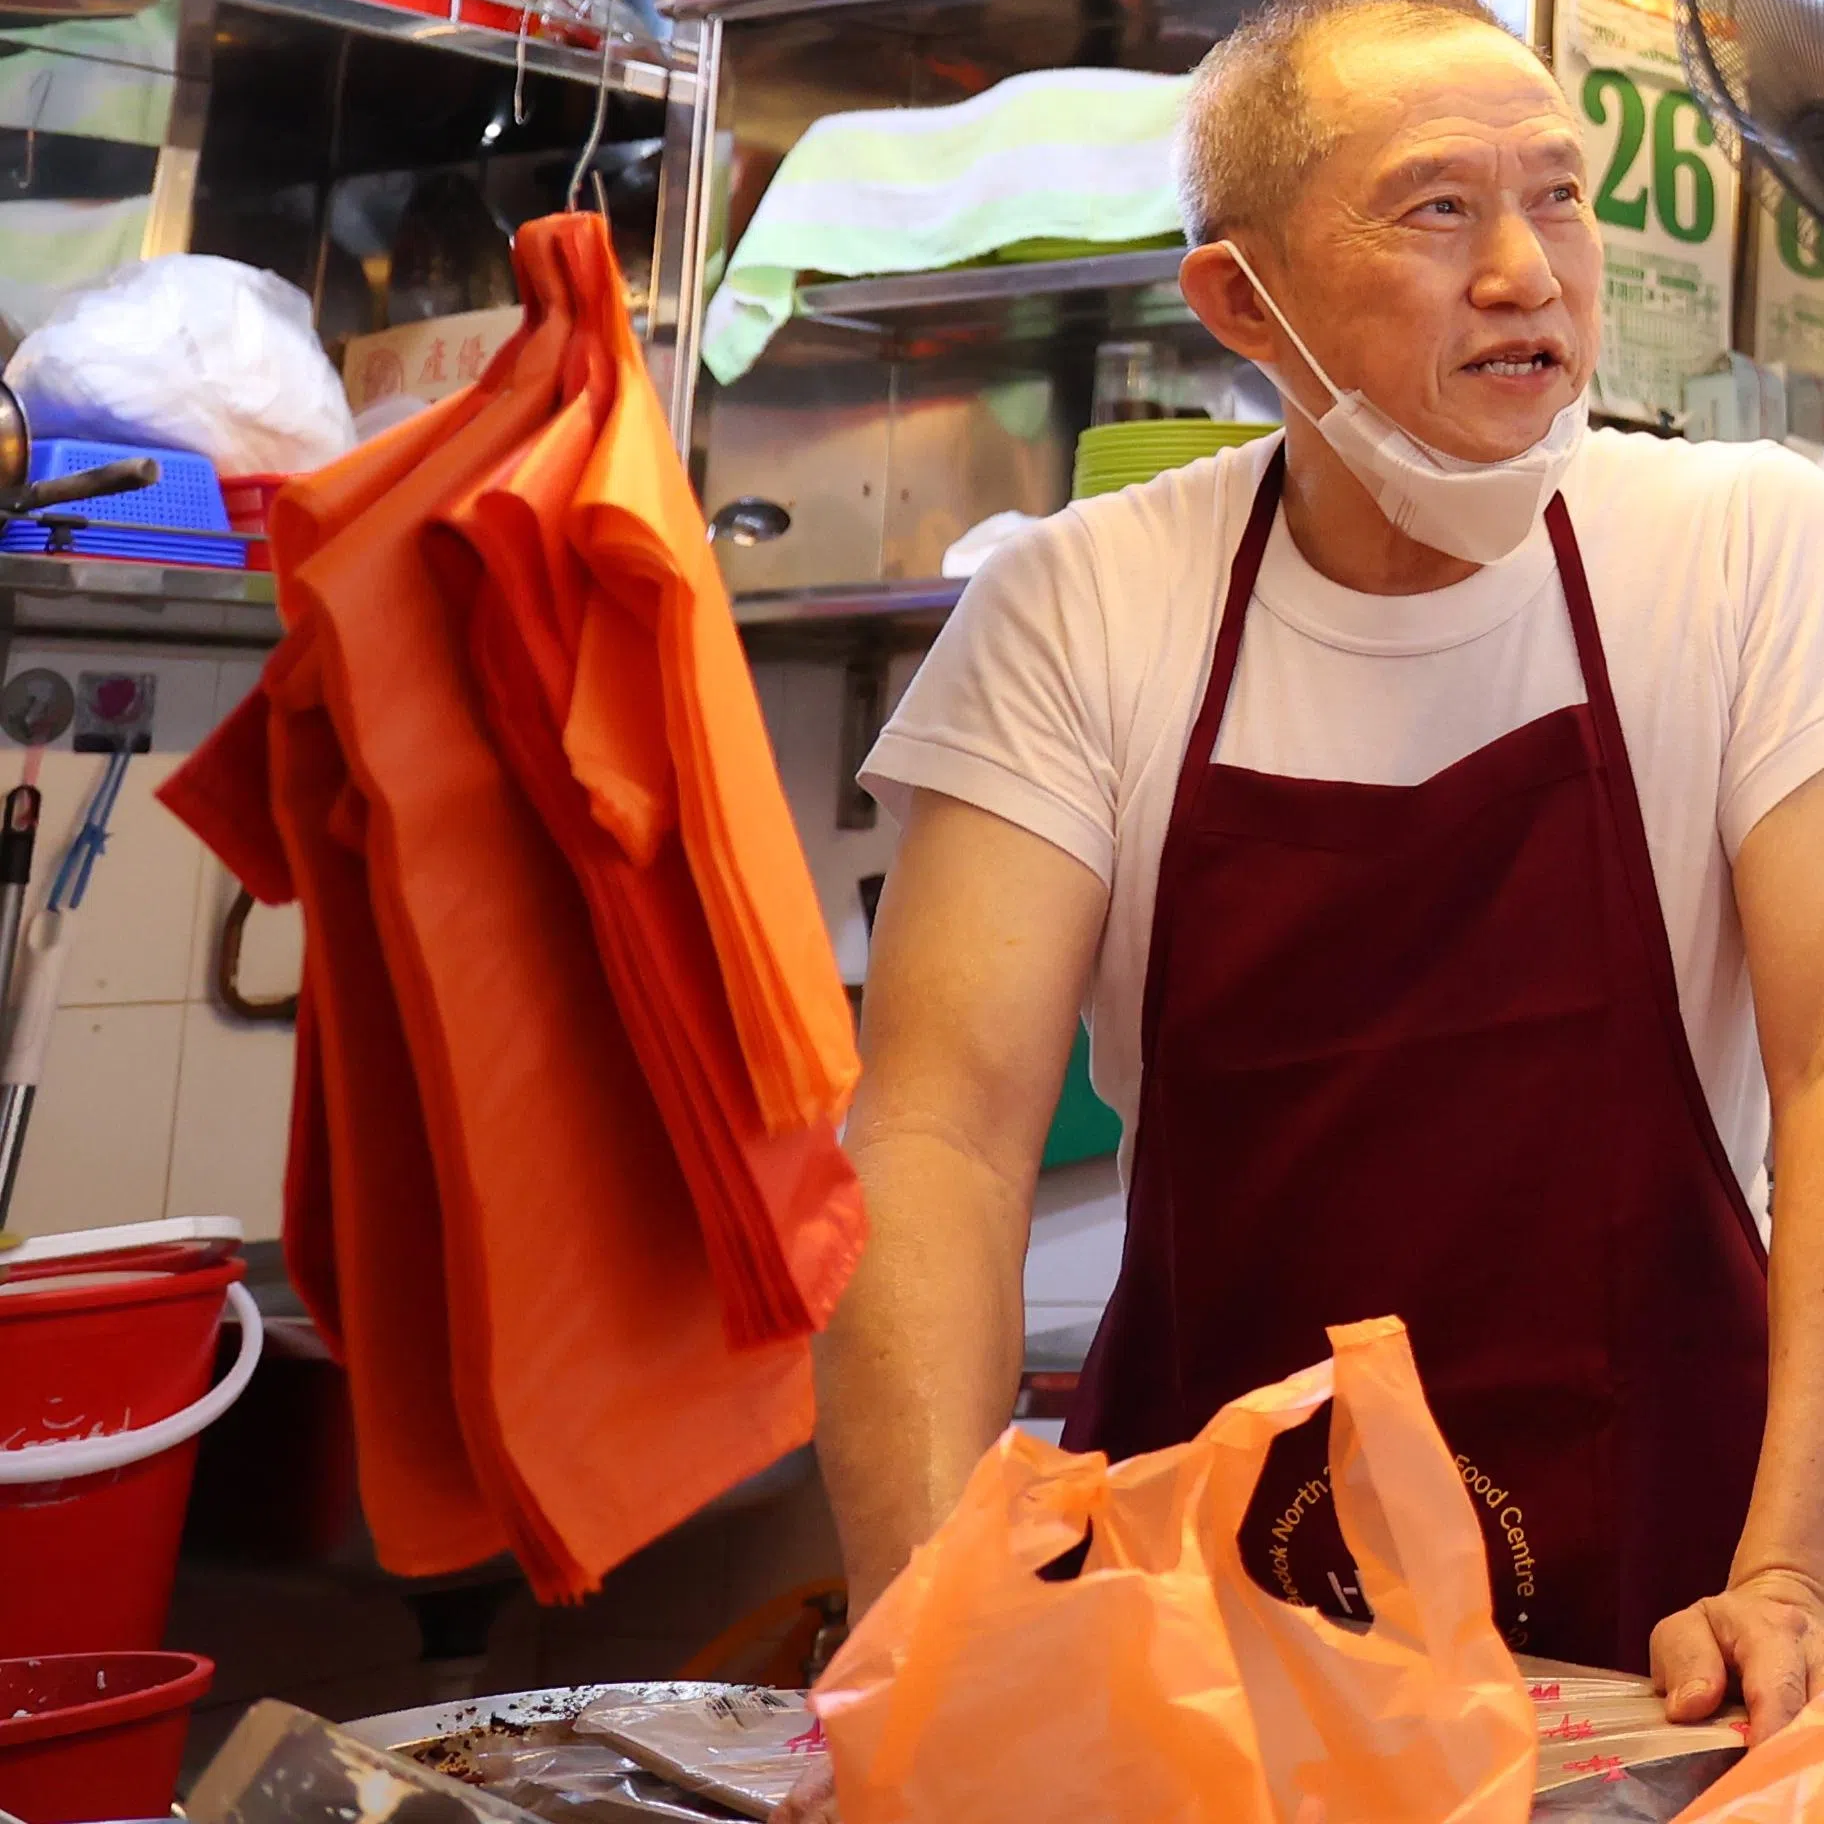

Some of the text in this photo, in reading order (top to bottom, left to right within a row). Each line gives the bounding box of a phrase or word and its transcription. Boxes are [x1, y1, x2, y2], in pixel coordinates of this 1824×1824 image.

[1582, 67, 1719, 244] 26
[1271, 1478, 1330, 1543] North
[1499, 1505, 1537, 1598] Centre
